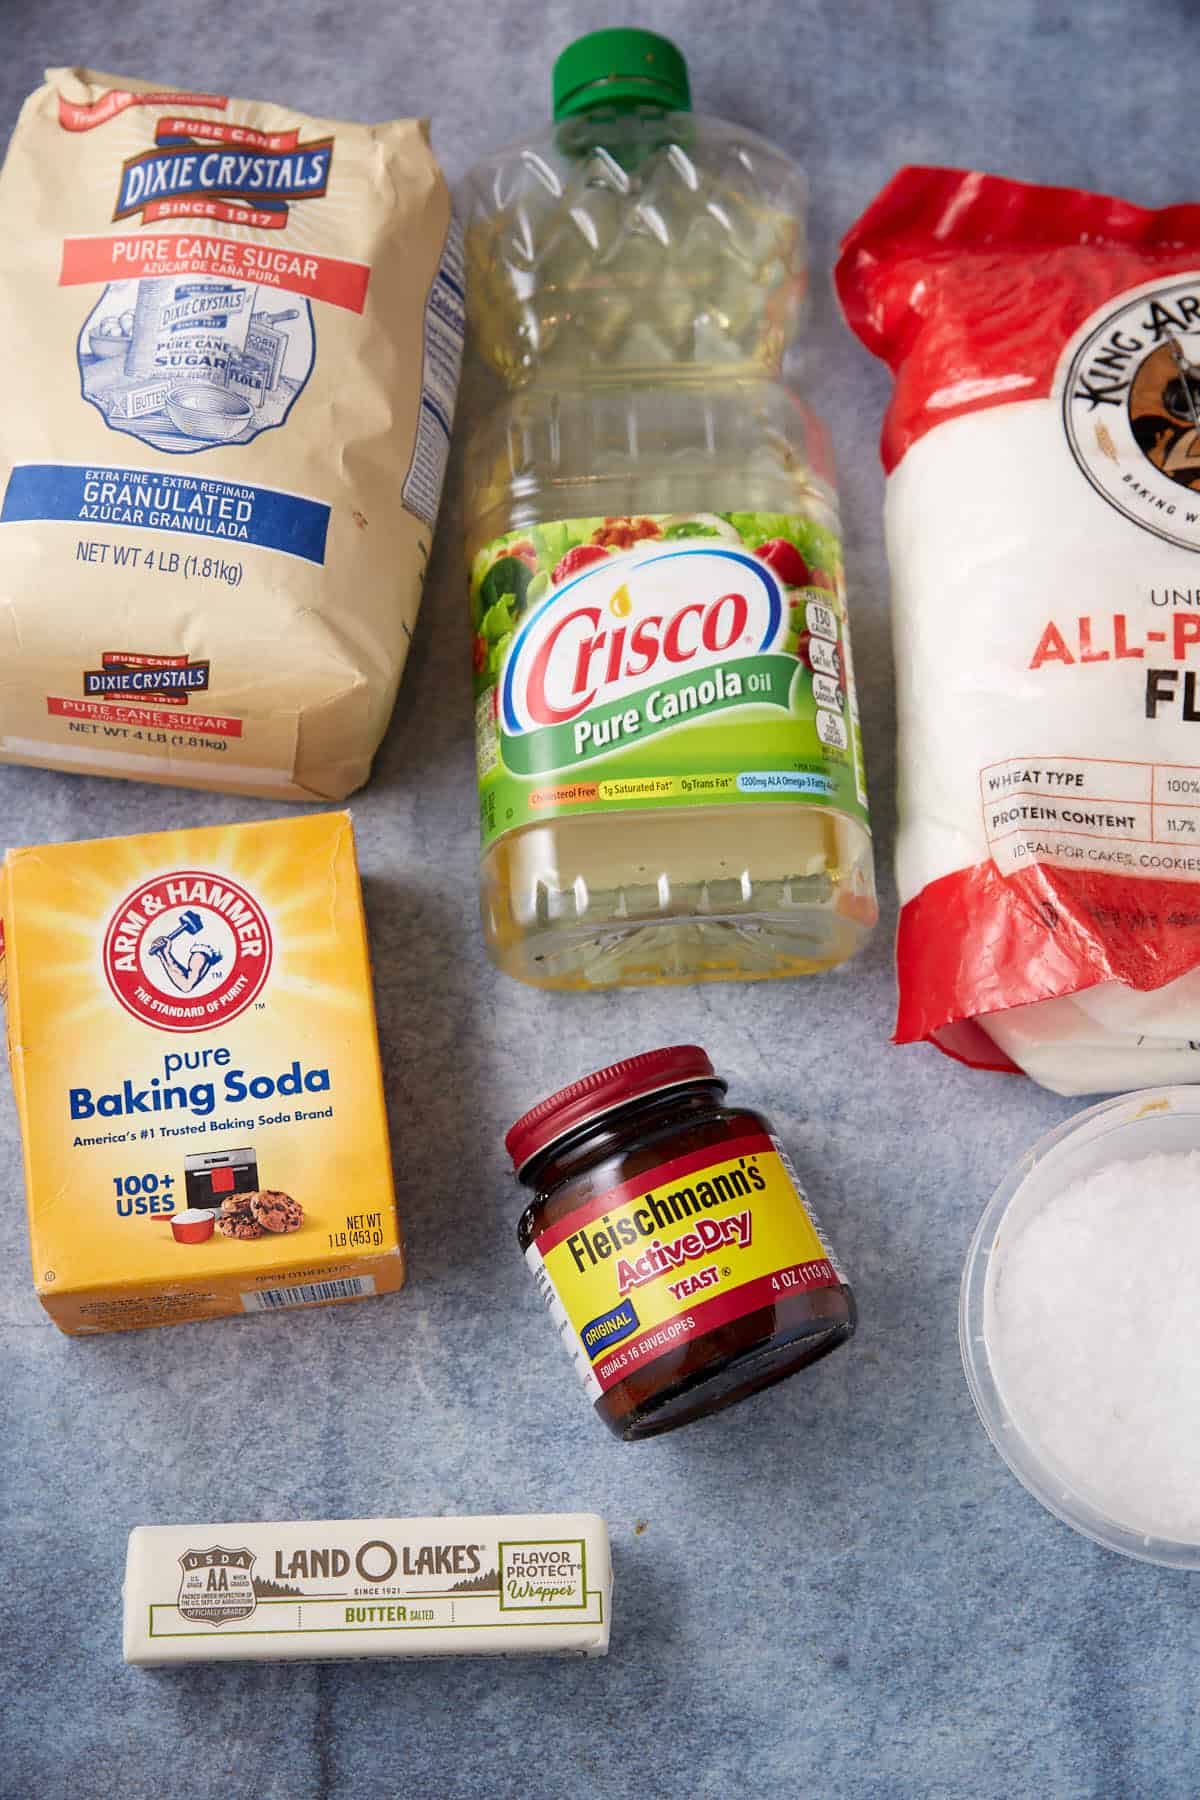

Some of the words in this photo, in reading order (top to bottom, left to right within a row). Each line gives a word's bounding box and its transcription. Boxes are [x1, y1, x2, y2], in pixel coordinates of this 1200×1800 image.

[172, 121, 224, 137] PURE
[231, 129, 281, 149] CANE
[124, 155, 198, 206] DIXIE
[200, 153, 324, 187] CRYSTALS
[158, 202, 217, 217] SINCE
[226, 209, 273, 225] 1917
[111, 239, 170, 264] PURE
[175, 238, 237, 263] CANE
[242, 247, 320, 280] SUGAR
[190, 260, 209, 272] DE
[247, 268, 281, 285] PURA
[162, 300, 191, 326] DIXIE
[191, 293, 242, 314] CRYSTALS
[156, 341, 192, 351] PURE
[194, 340, 230, 353] CANE
[153, 355, 227, 369] SUGAR
[1073, 330, 1144, 412] KING
[135, 389, 167, 411] BUTTER
[85, 470, 120, 481] EXTRA
[122, 472, 149, 485] FINE
[162, 476, 198, 491] EXTRA
[200, 481, 256, 502] REFINADA
[1121, 473, 1177, 515] BAKING
[83, 481, 253, 522] GRANULATED
[78, 504, 144, 524] AZÚCAR
[148, 511, 249, 539] GRANULADA
[76, 541, 111, 565] NET
[113, 545, 142, 568] WT
[143, 550, 155, 569] 4
[159, 551, 180, 573] LB
[183, 554, 243, 587] (1.81kg)
[112, 654, 145, 665] PURE
[146, 656, 178, 667] CANE
[525, 593, 749, 725] Crisco
[90, 674, 131, 692] DIXIE
[132, 670, 205, 689] CRYSTALS
[62, 701, 111, 716] PURE
[115, 707, 162, 722] CANE
[168, 713, 228, 730] SUGAR
[574, 708, 640, 754] Pure
[646, 668, 743, 724] Canola
[747, 673, 772, 692] Oil
[67, 722, 98, 734] NET
[103, 726, 129, 738] WT
[133, 730, 144, 741] 4
[147, 732, 168, 743] LB
[578, 787, 596, 797] Free
[603, 785, 614, 796] 1g
[615, 781, 655, 794] Saturated
[741, 777, 768, 789] 1200mg
[767, 777, 782, 786] ALA
[989, 771, 1042, 790] WHEAT
[1046, 771, 1085, 787] TYPE
[1167, 780, 1200, 794] 100%
[991, 806, 1057, 828] PROTEIN
[1061, 811, 1136, 830] CONTENT
[1167, 819, 1196, 833] 11.7%
[1013, 842, 1053, 859] IDEAL
[1056, 845, 1084, 859] FOR
[114, 910, 149, 973] ARM
[140, 893, 167, 916] &
[165, 880, 263, 959] HAMMER
[133, 985, 153, 1005] THE
[150, 999, 206, 1018] STANDARD
[206, 999, 220, 1013] OF
[220, 973, 249, 1006] PURITY
[164, 1046, 232, 1081] pure
[69, 1077, 215, 1120] Baking
[224, 1061, 331, 1103] Soda
[73, 1129, 137, 1147] America's
[140, 1127, 156, 1139] #1
[160, 1121, 207, 1138] Trusted
[209, 1114, 255, 1132] Baking
[258, 1111, 291, 1126] Soda
[295, 1105, 334, 1122] Brand
[113, 1172, 176, 1197] 100+
[115, 1193, 176, 1217] USES
[567, 1158, 767, 1273] Fleischmann's
[346, 1214, 365, 1230] NET
[366, 1213, 382, 1228] WT
[328, 1233, 333, 1249] 1
[335, 1232, 347, 1247] LB
[349, 1230, 371, 1248] (453
[373, 1228, 384, 1247] g)
[668, 1266, 721, 1301] YEAST
[770, 1277, 781, 1291] 4
[781, 1270, 800, 1287] OZ
[585, 1311, 632, 1347] ORIGINAL
[600, 1349, 628, 1379] EQUALS
[628, 1345, 640, 1360] 16
[640, 1315, 696, 1355] ENVELOPES
[189, 1554, 245, 1567] USDA
[275, 1549, 351, 1579] LAND
[355, 1540, 398, 1583] O
[403, 1544, 481, 1575] LAKES
[512, 1551, 571, 1565] FLAVOR
[207, 1567, 229, 1591] AA
[507, 1579, 577, 1602] Wrapper
[353, 1587, 380, 1596] SINCE
[382, 1587, 401, 1595] 1921
[345, 1606, 407, 1623] BUTTER
[410, 1609, 434, 1621] SALTED
